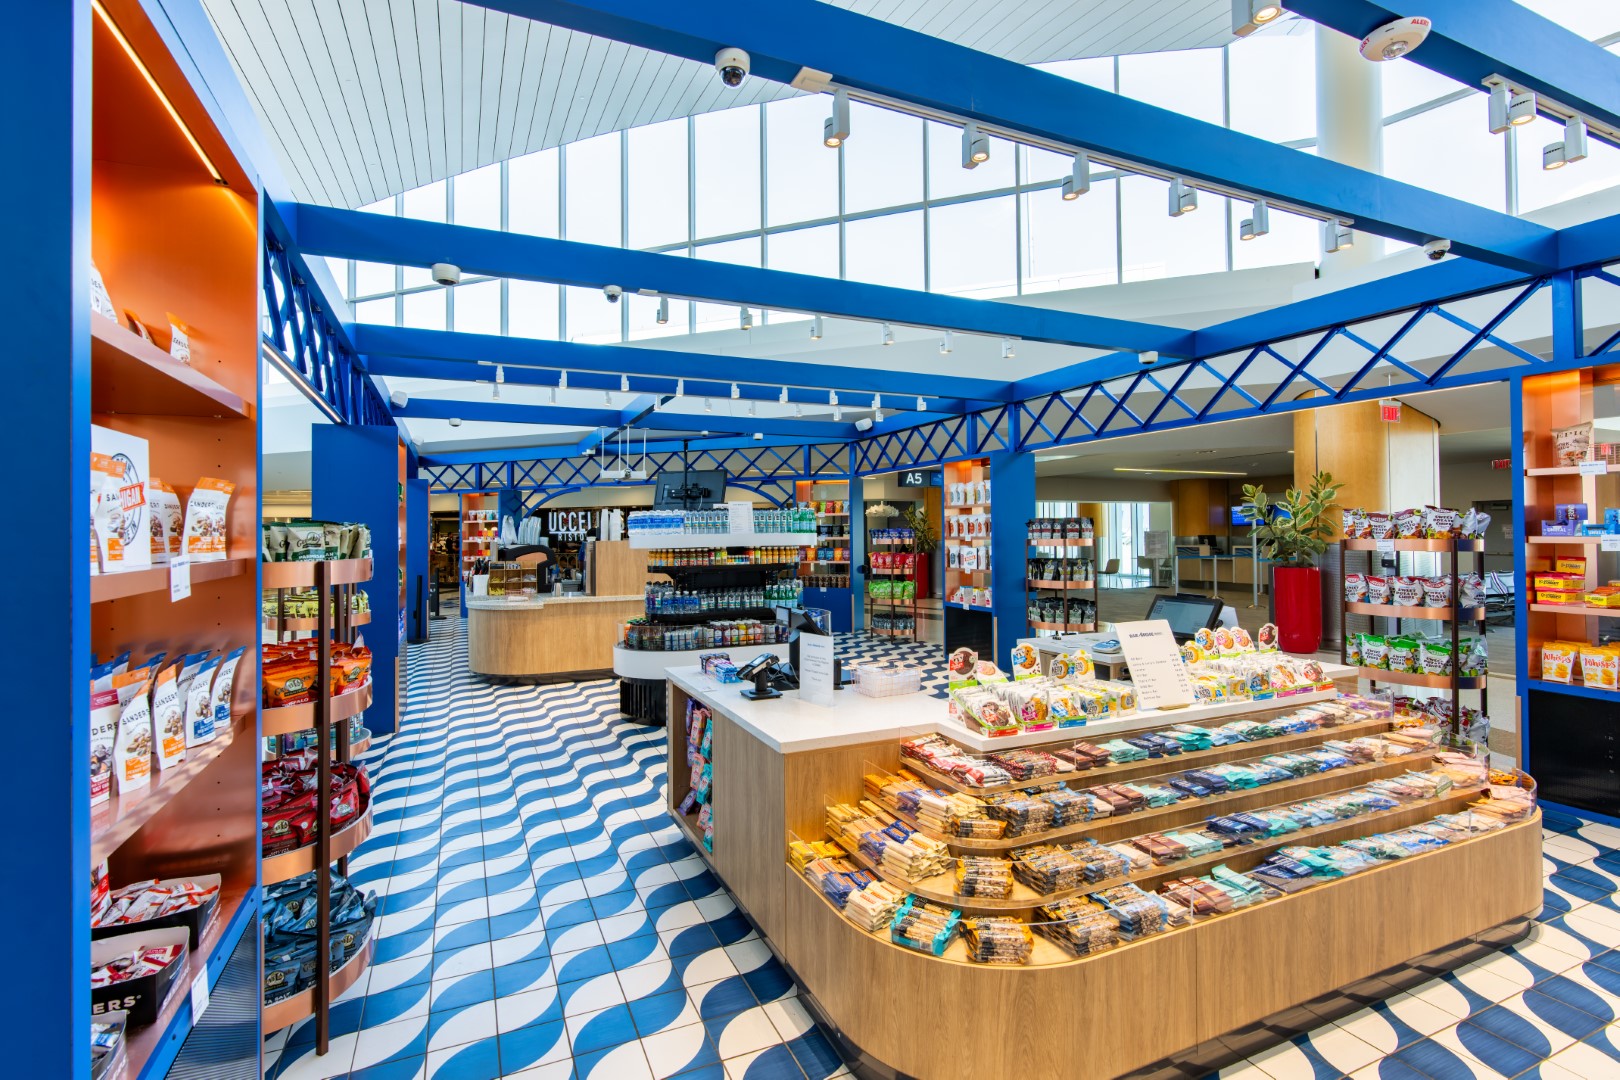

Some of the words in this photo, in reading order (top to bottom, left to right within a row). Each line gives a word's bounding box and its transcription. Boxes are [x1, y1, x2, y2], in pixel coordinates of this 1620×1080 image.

[1410, 18, 1430, 26] ALERT
[1360, 37, 1370, 53] LERT
[1383, 406, 1399, 420] EXIT
[906, 472, 923, 485] A5
[558, 533, 587, 542] RISTO
[1584, 657, 1617, 669] Whisps
[122, 708, 151, 725] SANDERS
[91, 723, 119, 736] DERS
[92, 995, 136, 1015] ERS
